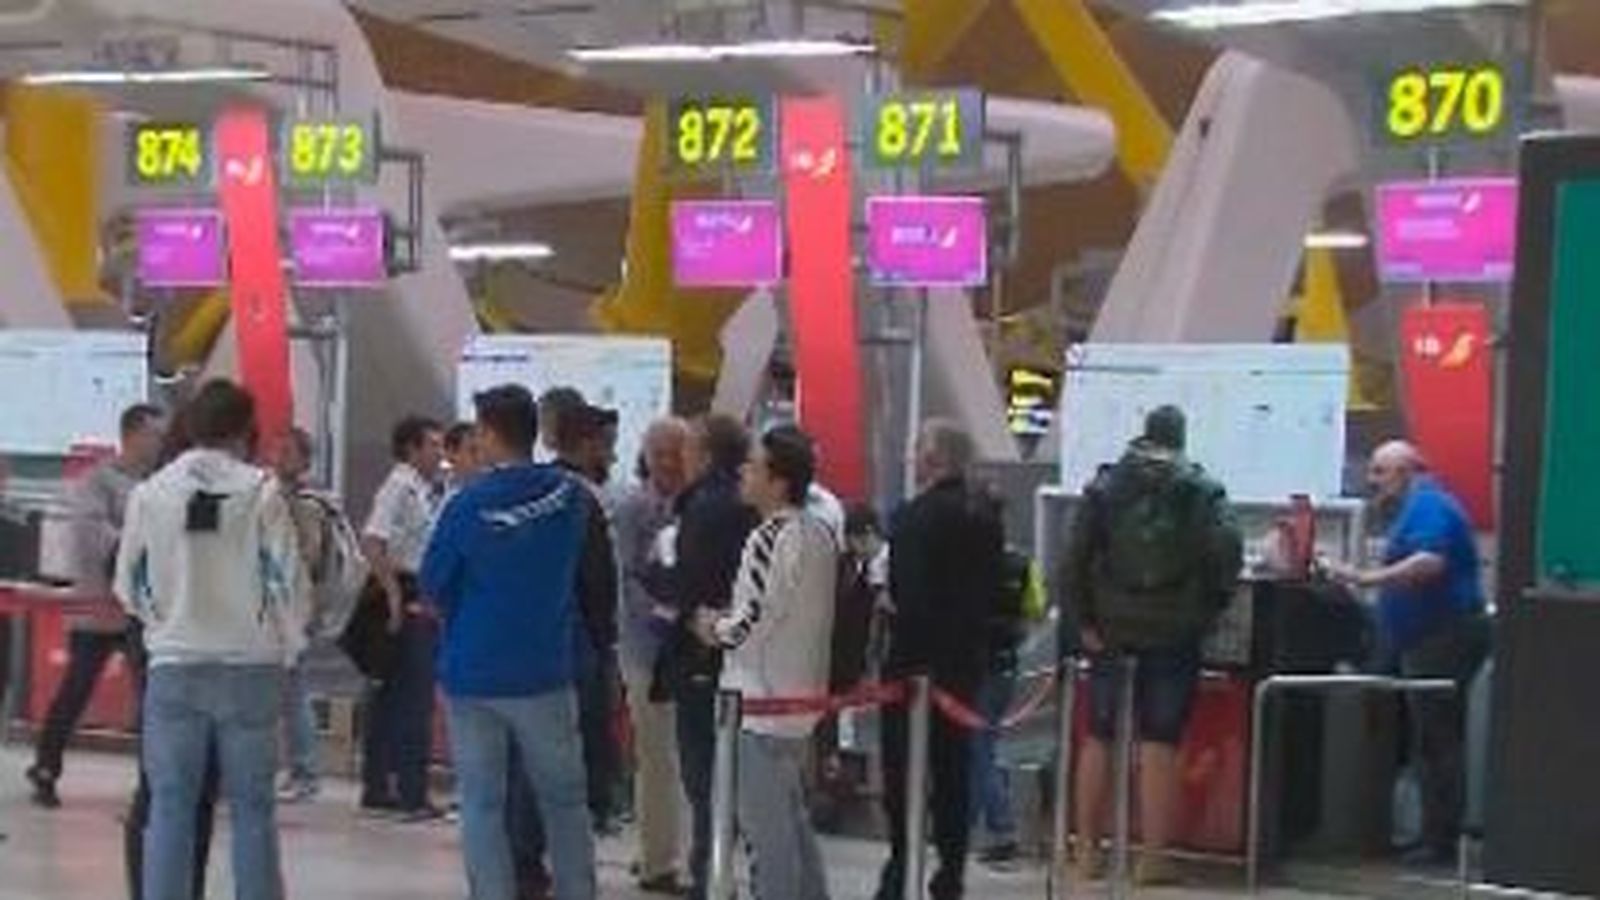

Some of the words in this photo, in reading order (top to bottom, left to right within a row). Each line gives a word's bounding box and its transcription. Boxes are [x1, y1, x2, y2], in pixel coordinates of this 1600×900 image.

[876, 101, 961, 157] 871
[1389, 68, 1503, 138] 870
[136, 129, 201, 177] 874
[290, 123, 363, 173] 873
[677, 106, 759, 163] 872
